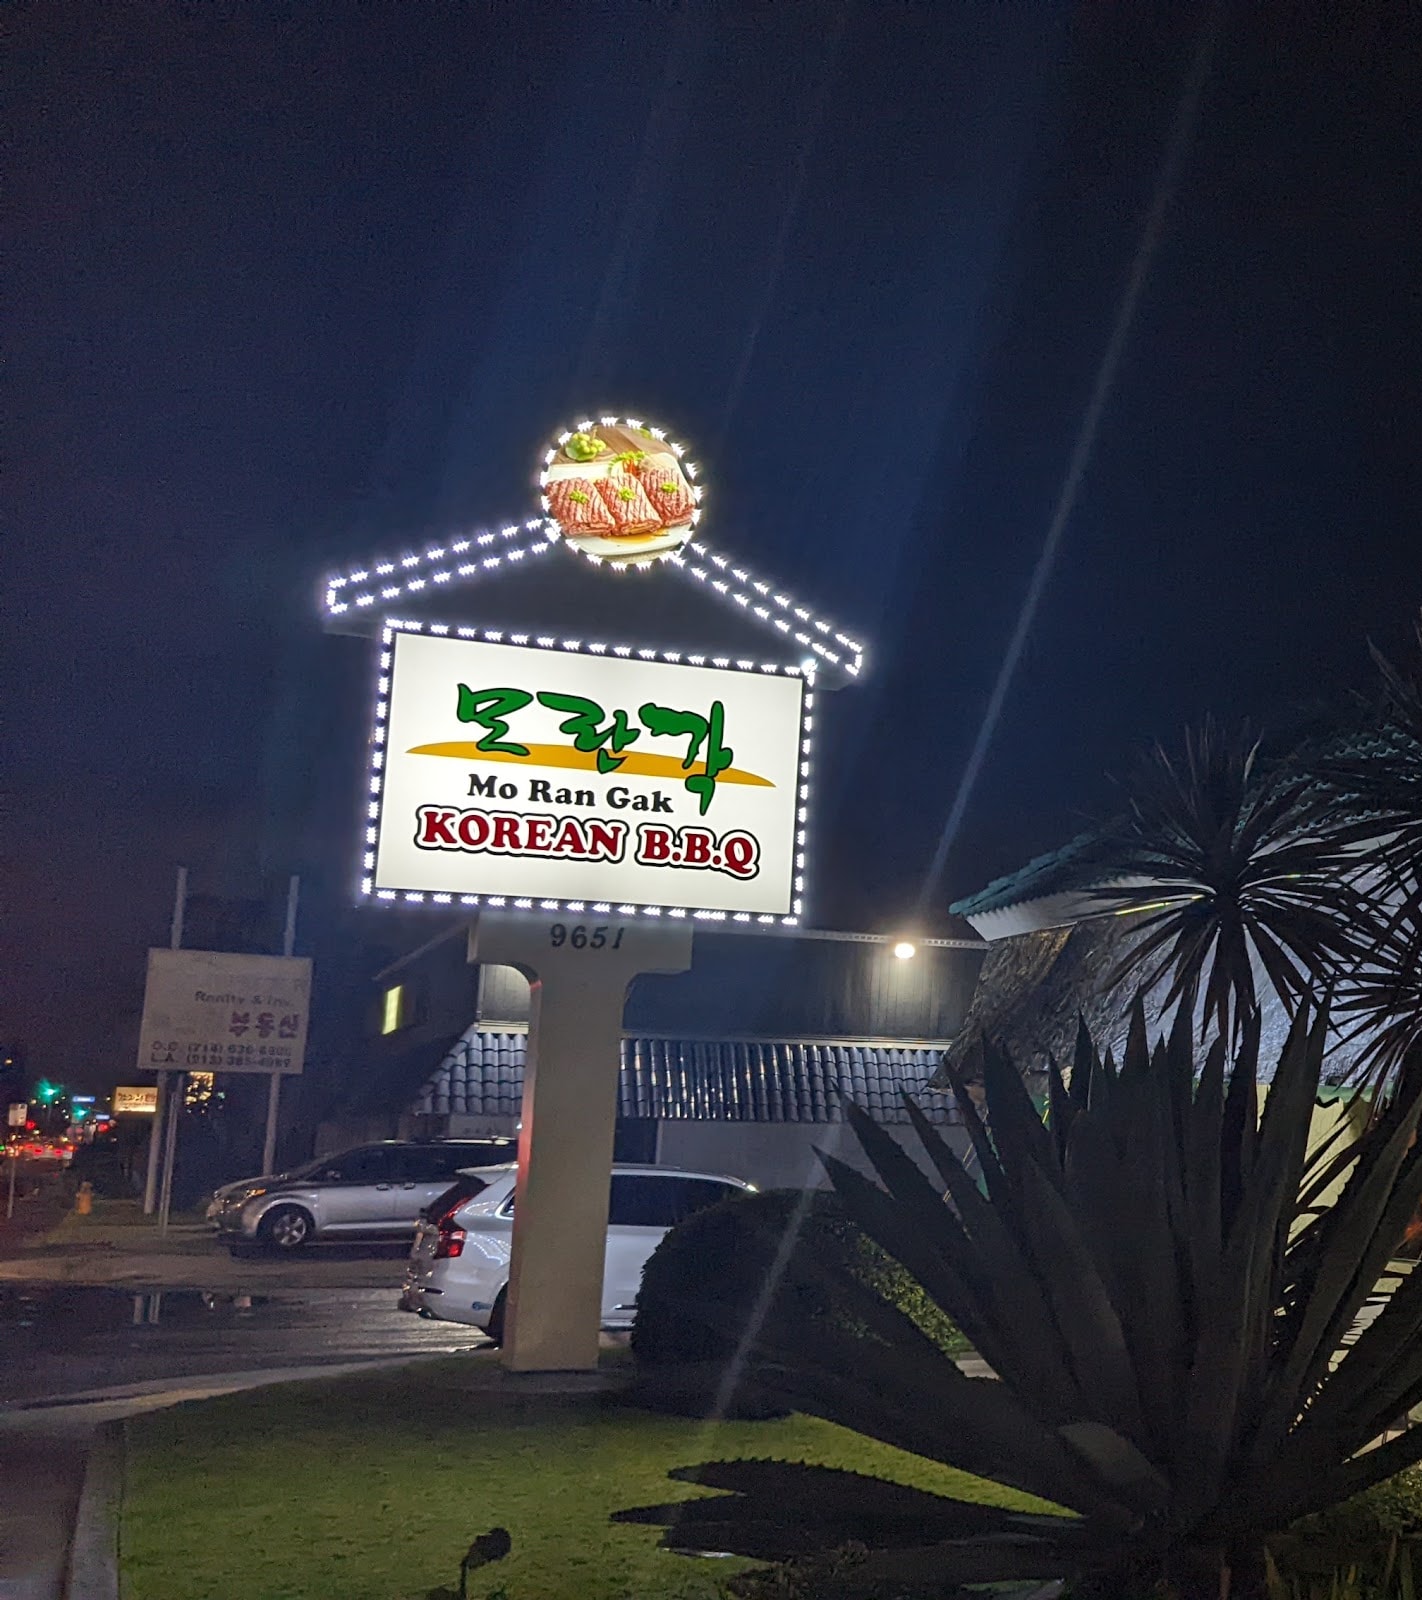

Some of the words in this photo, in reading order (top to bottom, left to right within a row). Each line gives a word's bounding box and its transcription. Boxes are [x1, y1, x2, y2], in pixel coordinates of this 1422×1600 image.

[456, 683, 734, 816] 모란각
[467, 774, 519, 800] Mo
[528, 780, 596, 807] Ran
[606, 786, 674, 813] Gak
[420, 809, 626, 859] KOREAN
[640, 828, 758, 876] B.B.Q
[549, 924, 625, 950] 9651
[228, 1011, 300, 1039] 부동산
[187, 1042, 223, 1054] (714)
